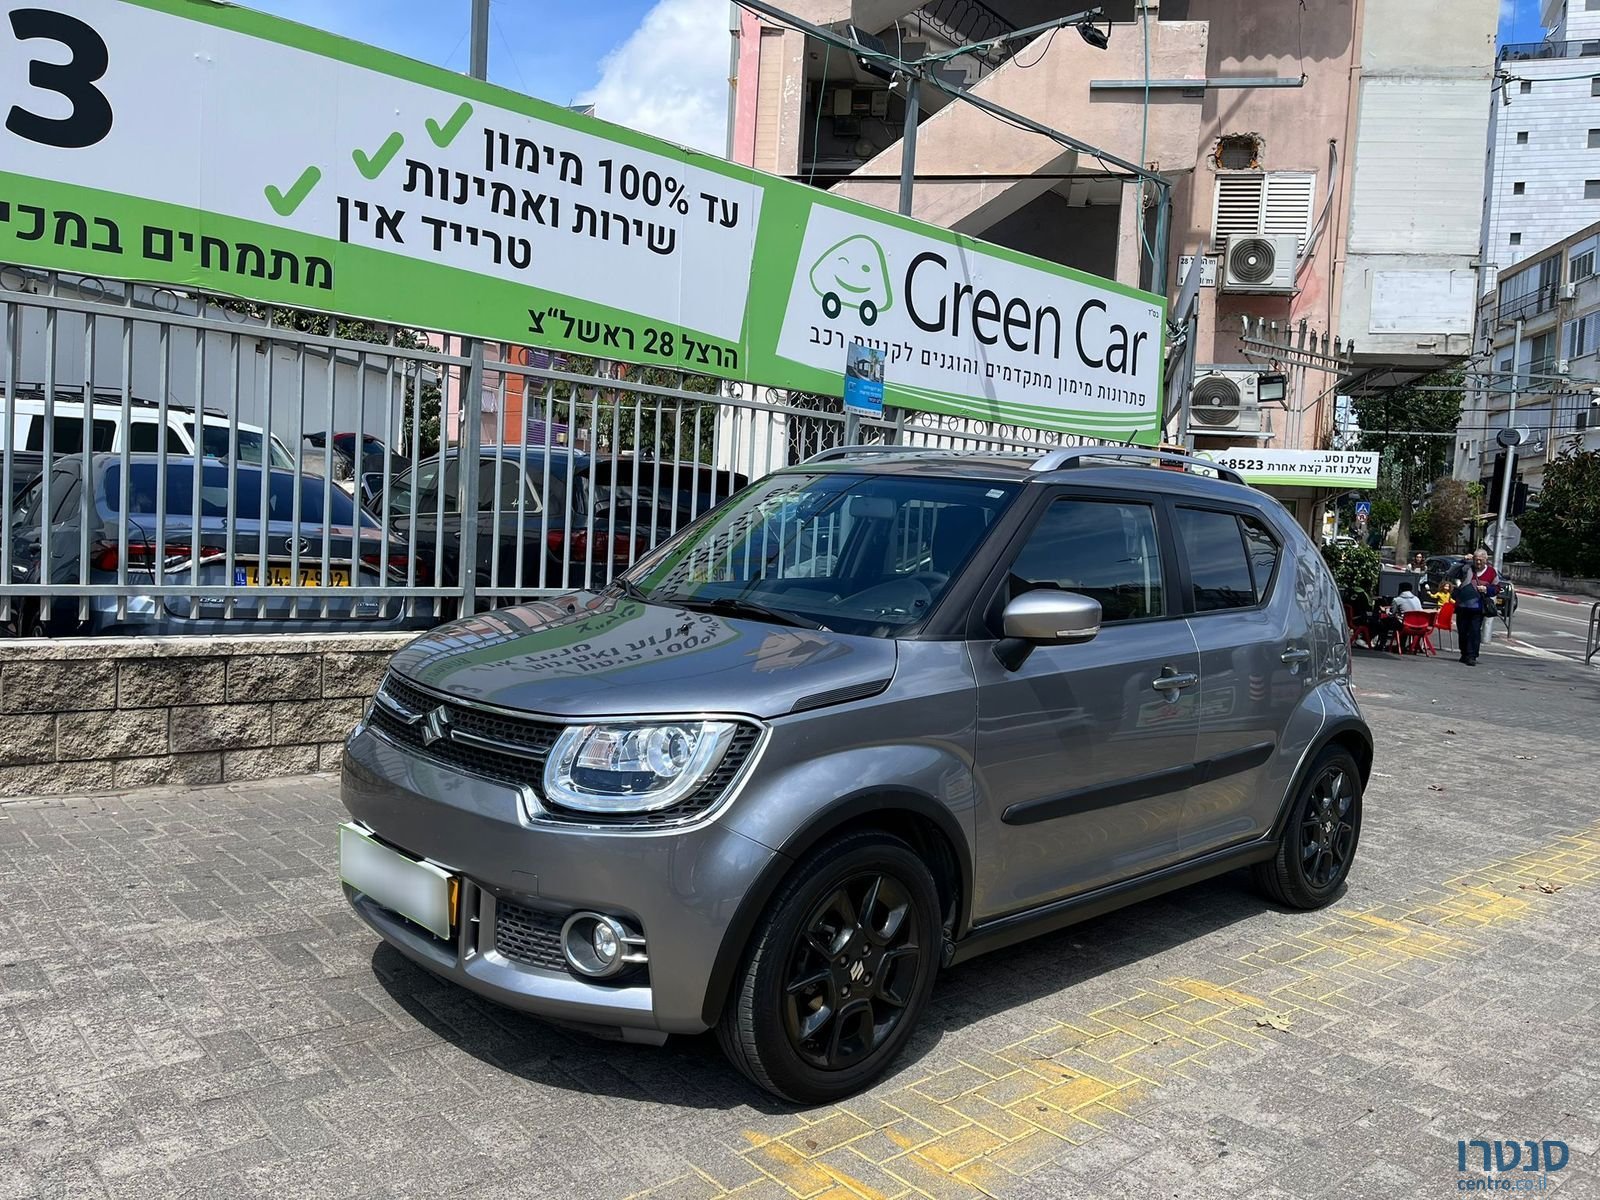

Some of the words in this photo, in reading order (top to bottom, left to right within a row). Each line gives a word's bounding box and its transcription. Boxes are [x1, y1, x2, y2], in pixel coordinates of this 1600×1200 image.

[6, 8, 113, 149] 3
[484, 128, 583, 186] מימון
[403, 159, 559, 229] ואמינות
[598, 160, 690, 216] 100%
[337, 197, 405, 243] אין
[700, 193, 739, 229] עד
[421, 216, 532, 269] טרייד
[571, 203, 676, 256] שירות
[142, 225, 334, 291] מתמחים
[528, 306, 635, 350] ראשל"צ
[904, 251, 1062, 360] Green
[1075, 299, 1148, 377] Car
[643, 328, 674, 356] 28
[681, 334, 738, 369] הרצל
[809, 326, 844, 349] רכב
[921, 350, 978, 375] והוגנים
[985, 362, 1052, 389] מתקדמים
[1058, 377, 1092, 396] מימון
[1097, 385, 1146, 406] פתרונות
[1267, 463, 1296, 472] אחרת
[1299, 463, 1321, 475] קצת
[1325, 464, 1337, 473] זה
[1340, 464, 1371, 474] אצלנו
[1347, 455, 1372, 465] שלם
